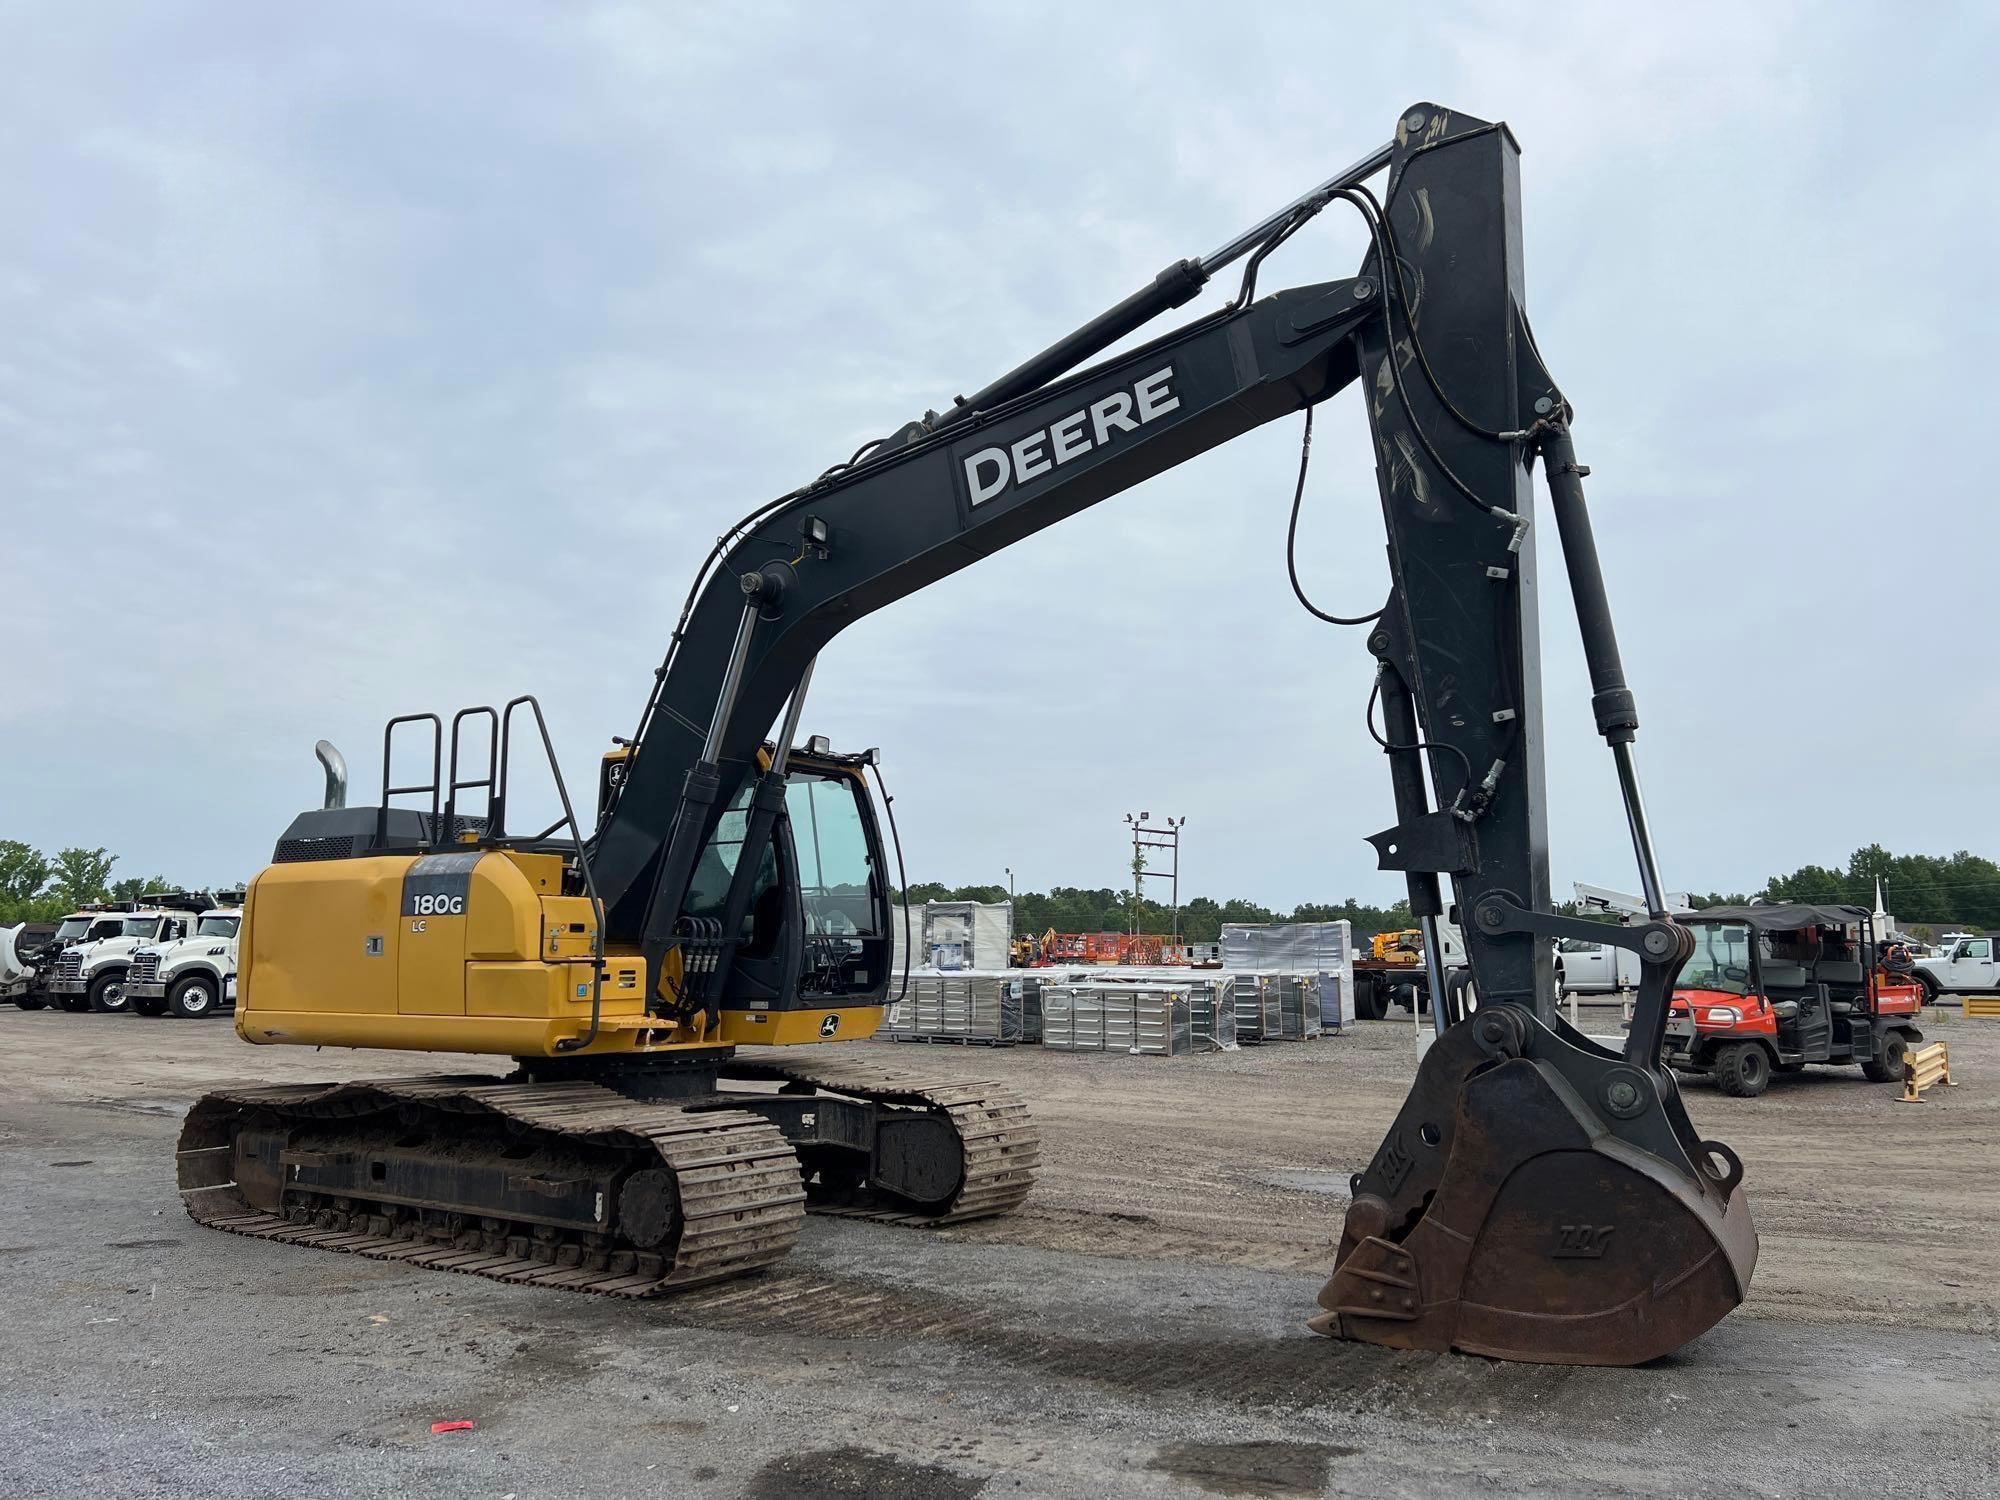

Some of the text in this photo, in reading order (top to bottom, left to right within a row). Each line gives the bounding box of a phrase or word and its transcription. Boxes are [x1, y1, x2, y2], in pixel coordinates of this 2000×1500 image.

[964, 365, 1181, 506] DEERE
[413, 894, 463, 915] 180G
[411, 920, 426, 932] LC
